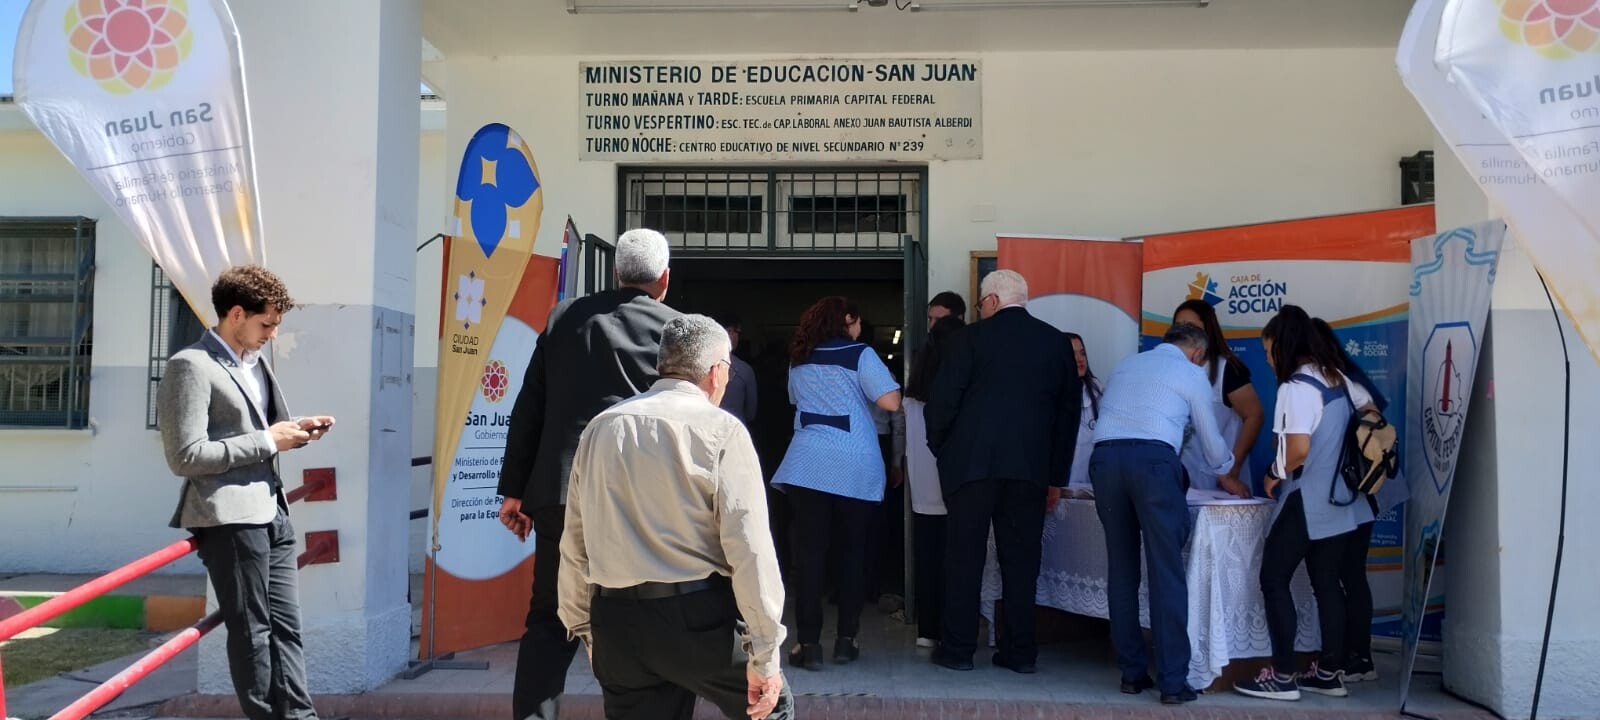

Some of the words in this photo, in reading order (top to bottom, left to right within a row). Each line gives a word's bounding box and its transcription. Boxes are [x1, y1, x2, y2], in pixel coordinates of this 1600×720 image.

[586, 66, 702, 84] MINISTERIO
[711, 66, 737, 83] DE
[921, 64, 976, 82] JUAN
[586, 93, 629, 107] TURNO
[632, 90, 685, 107] MAÑANA
[697, 92, 743, 106] TARDE:
[745, 95, 786, 106] ESCUELA
[790, 95, 840, 105] PRIMARIA
[844, 94, 888, 105] CAPITAL
[892, 94, 936, 105] FEDERAL
[586, 115, 631, 130] TURNO
[634, 115, 719, 130] VESPERTINO:
[833, 118, 861, 128] ANEXO
[863, 118, 886, 128] JUAN
[888, 118, 932, 128] BAUTISTA
[935, 117, 972, 128] ALBERDI
[586, 138, 630, 153] TURNO
[632, 137, 676, 153] NOCHE:
[679, 142, 717, 152] CENTRO
[720, 142, 773, 152] EDUCATIVO
[776, 142, 789, 152] DE
[792, 142, 820, 152] NIVEL
[824, 141, 885, 152] SECUNDARIO
[1231, 275, 1249, 283] CAJA
[1250, 274, 1261, 282] DE
[1228, 279, 1287, 299] ACCIÓN
[453, 333, 479, 346] CIUDAD
[452, 344, 463, 353] San
[465, 411, 487, 426] San
[490, 411, 512, 427] Jua
[455, 457, 489, 467] Ministerio
[490, 456, 499, 466] de
[452, 473, 458, 483] y
[459, 469, 496, 480] Desarrollo
[451, 497, 483, 509] Dirección
[484, 496, 493, 506] de
[460, 512, 477, 523] para
[478, 510, 485, 519] la
